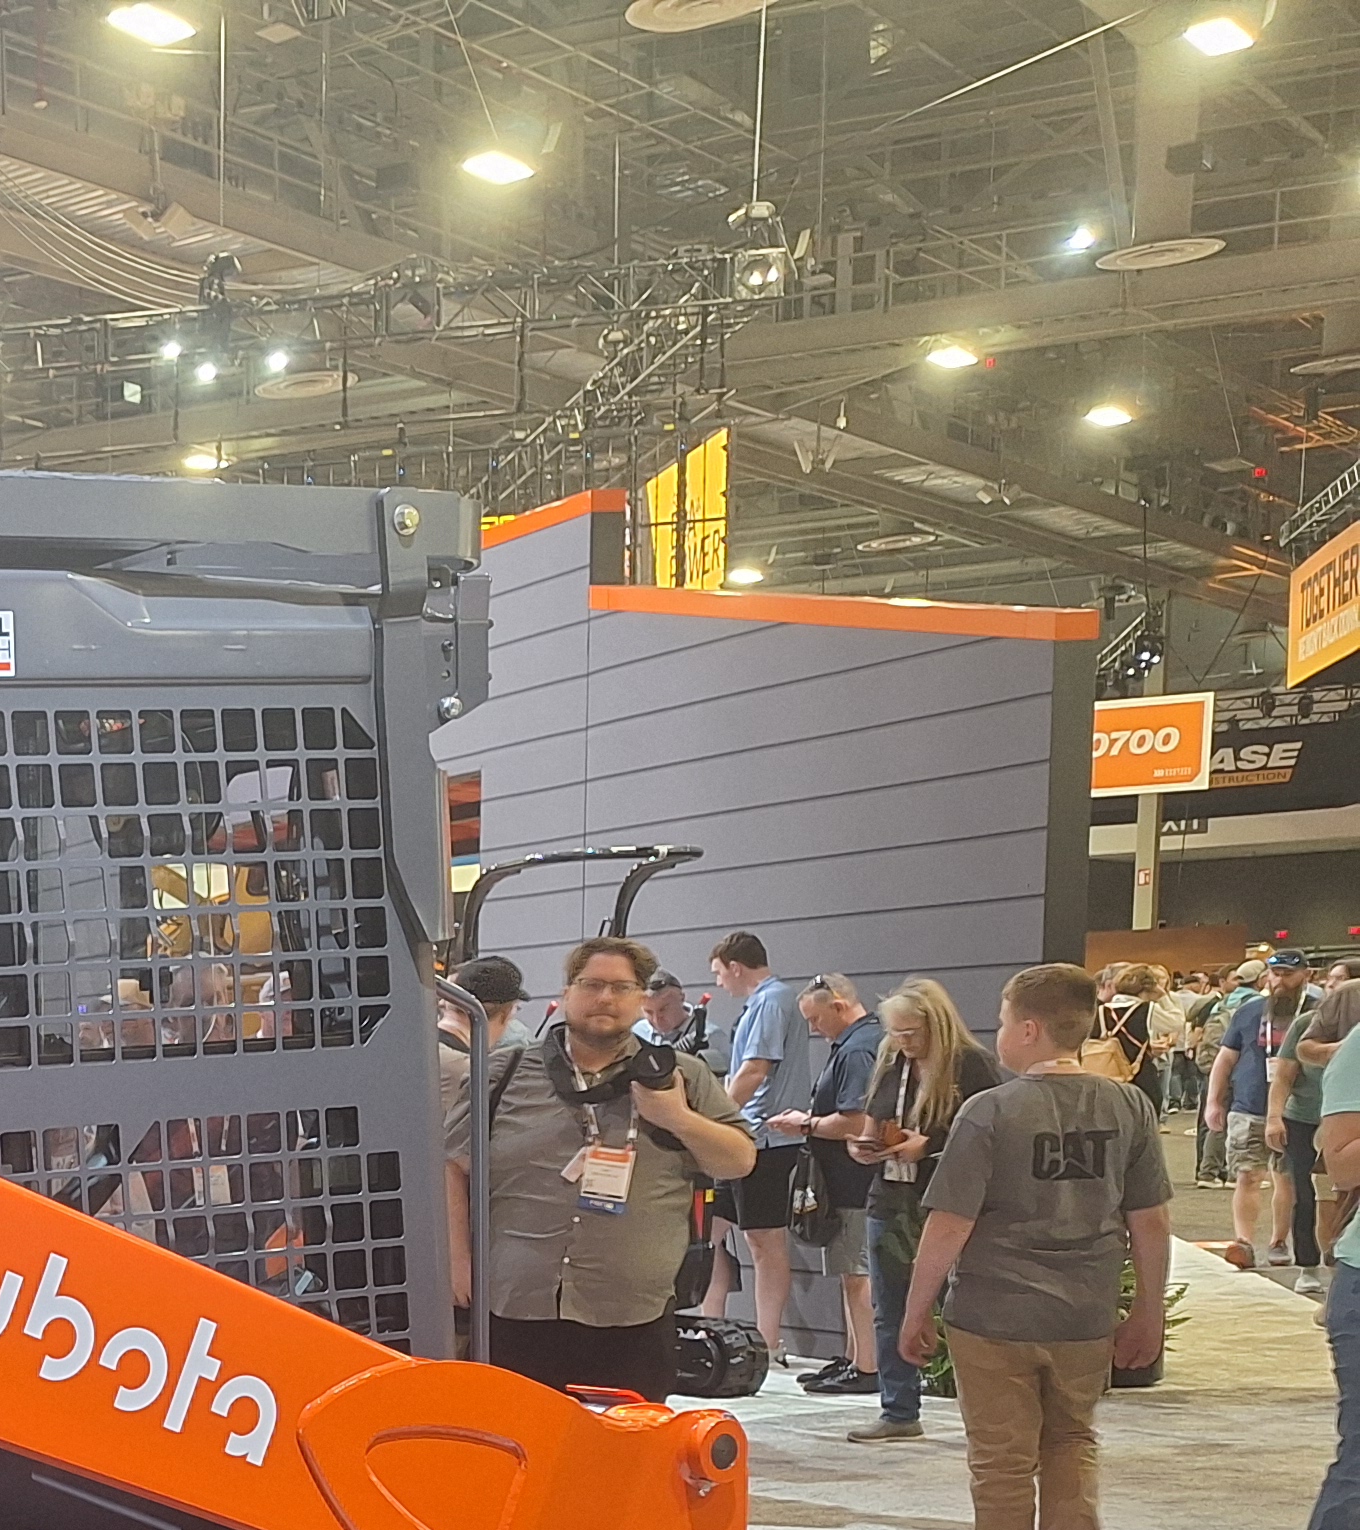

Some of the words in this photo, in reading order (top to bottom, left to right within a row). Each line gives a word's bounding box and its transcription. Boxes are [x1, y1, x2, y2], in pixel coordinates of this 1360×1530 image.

[1300, 543, 1359, 631] TOGETHER
[1210, 741, 1303, 772] ASE
[1210, 771, 1288, 786] STRUCTION
[1032, 1130, 1119, 1180] CAT
